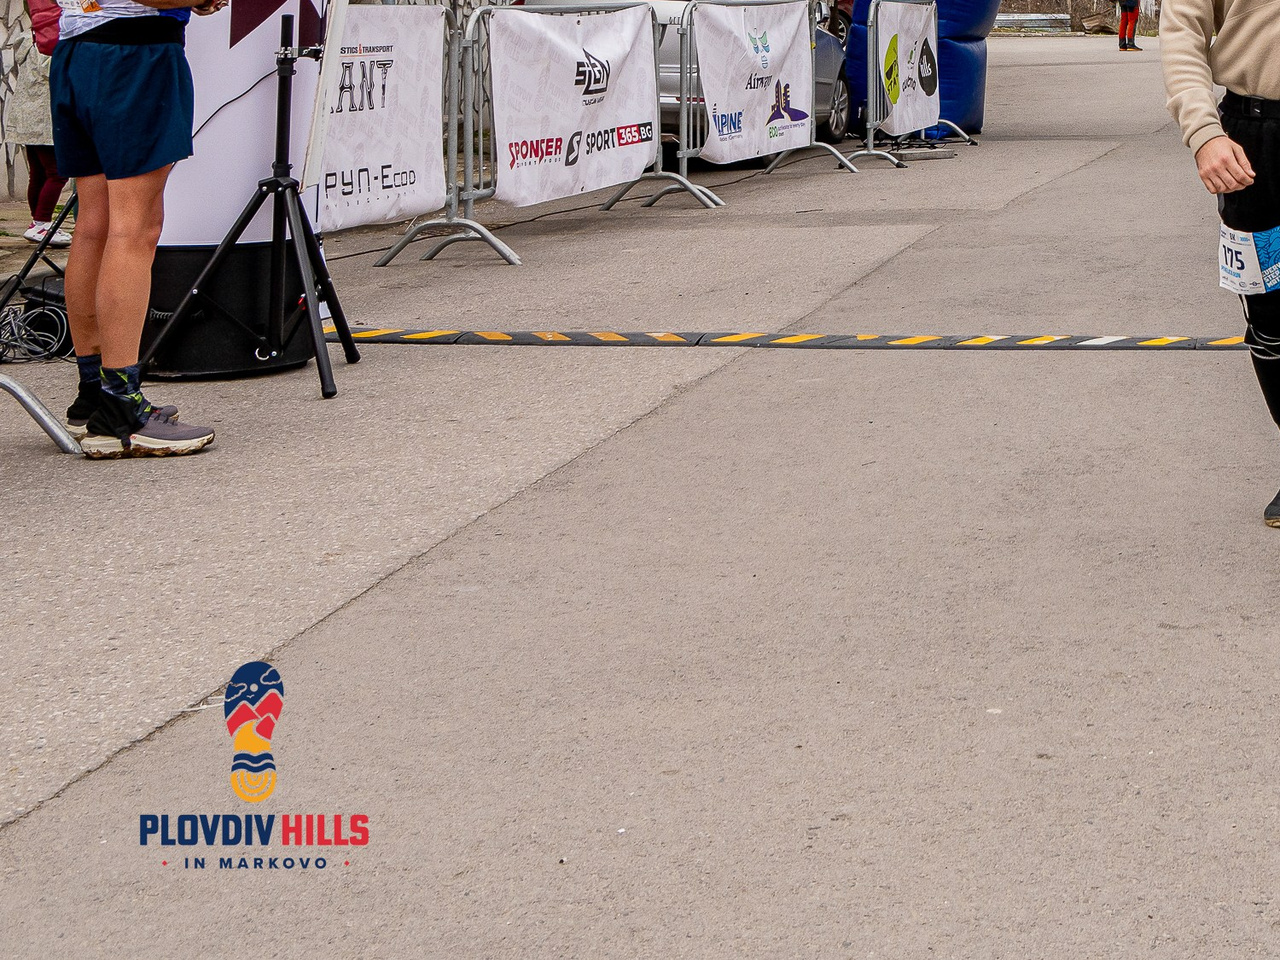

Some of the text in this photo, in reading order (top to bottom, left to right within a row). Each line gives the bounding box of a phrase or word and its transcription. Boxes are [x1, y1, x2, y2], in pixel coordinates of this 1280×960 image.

[340, 46, 358, 54] STICS
[362, 45, 394, 54] TRANSPORT
[330, 60, 394, 114] ANT
[508, 137, 563, 170] SPONSER
[585, 128, 616, 155] SPORT
[1223, 244, 1245, 270] 175
